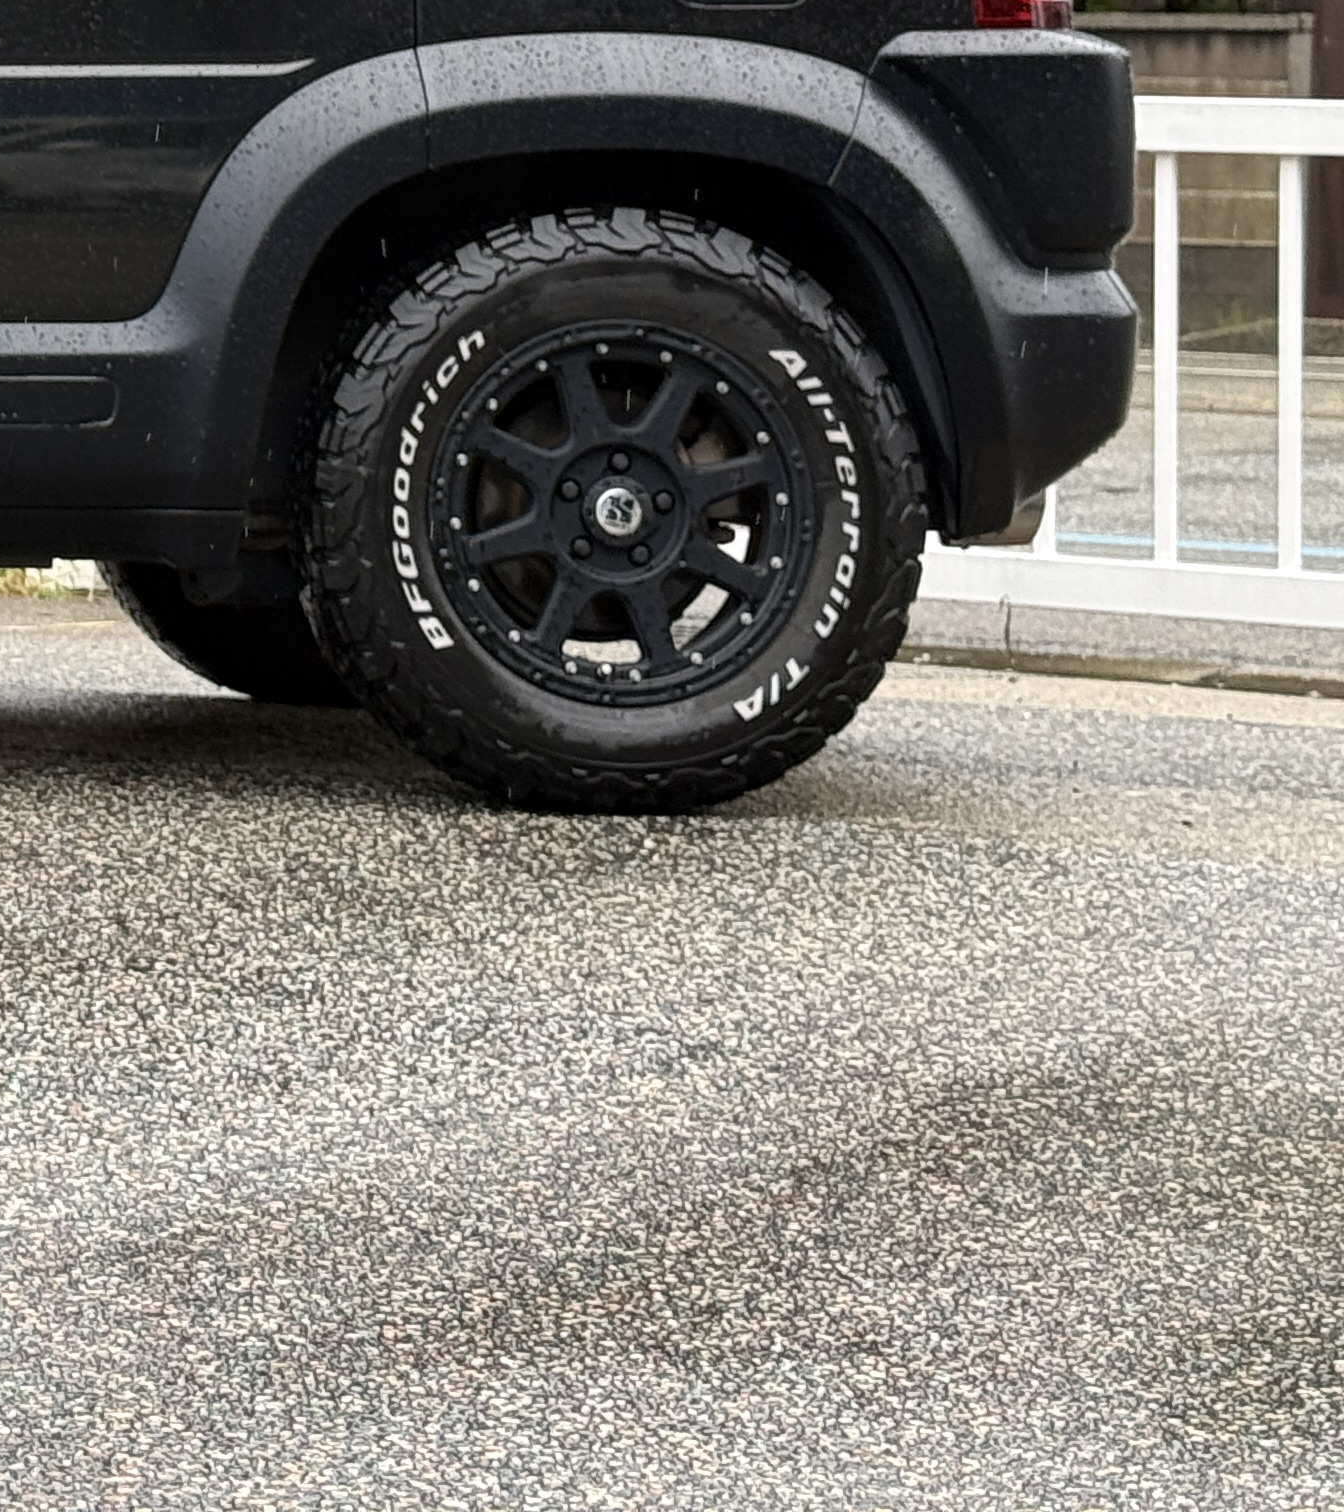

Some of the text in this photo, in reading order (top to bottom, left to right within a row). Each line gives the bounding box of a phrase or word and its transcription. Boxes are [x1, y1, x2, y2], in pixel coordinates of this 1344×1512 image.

[392, 330, 486, 650] BFGoodrich
[733, 349, 861, 721] All-Terrain T/A
